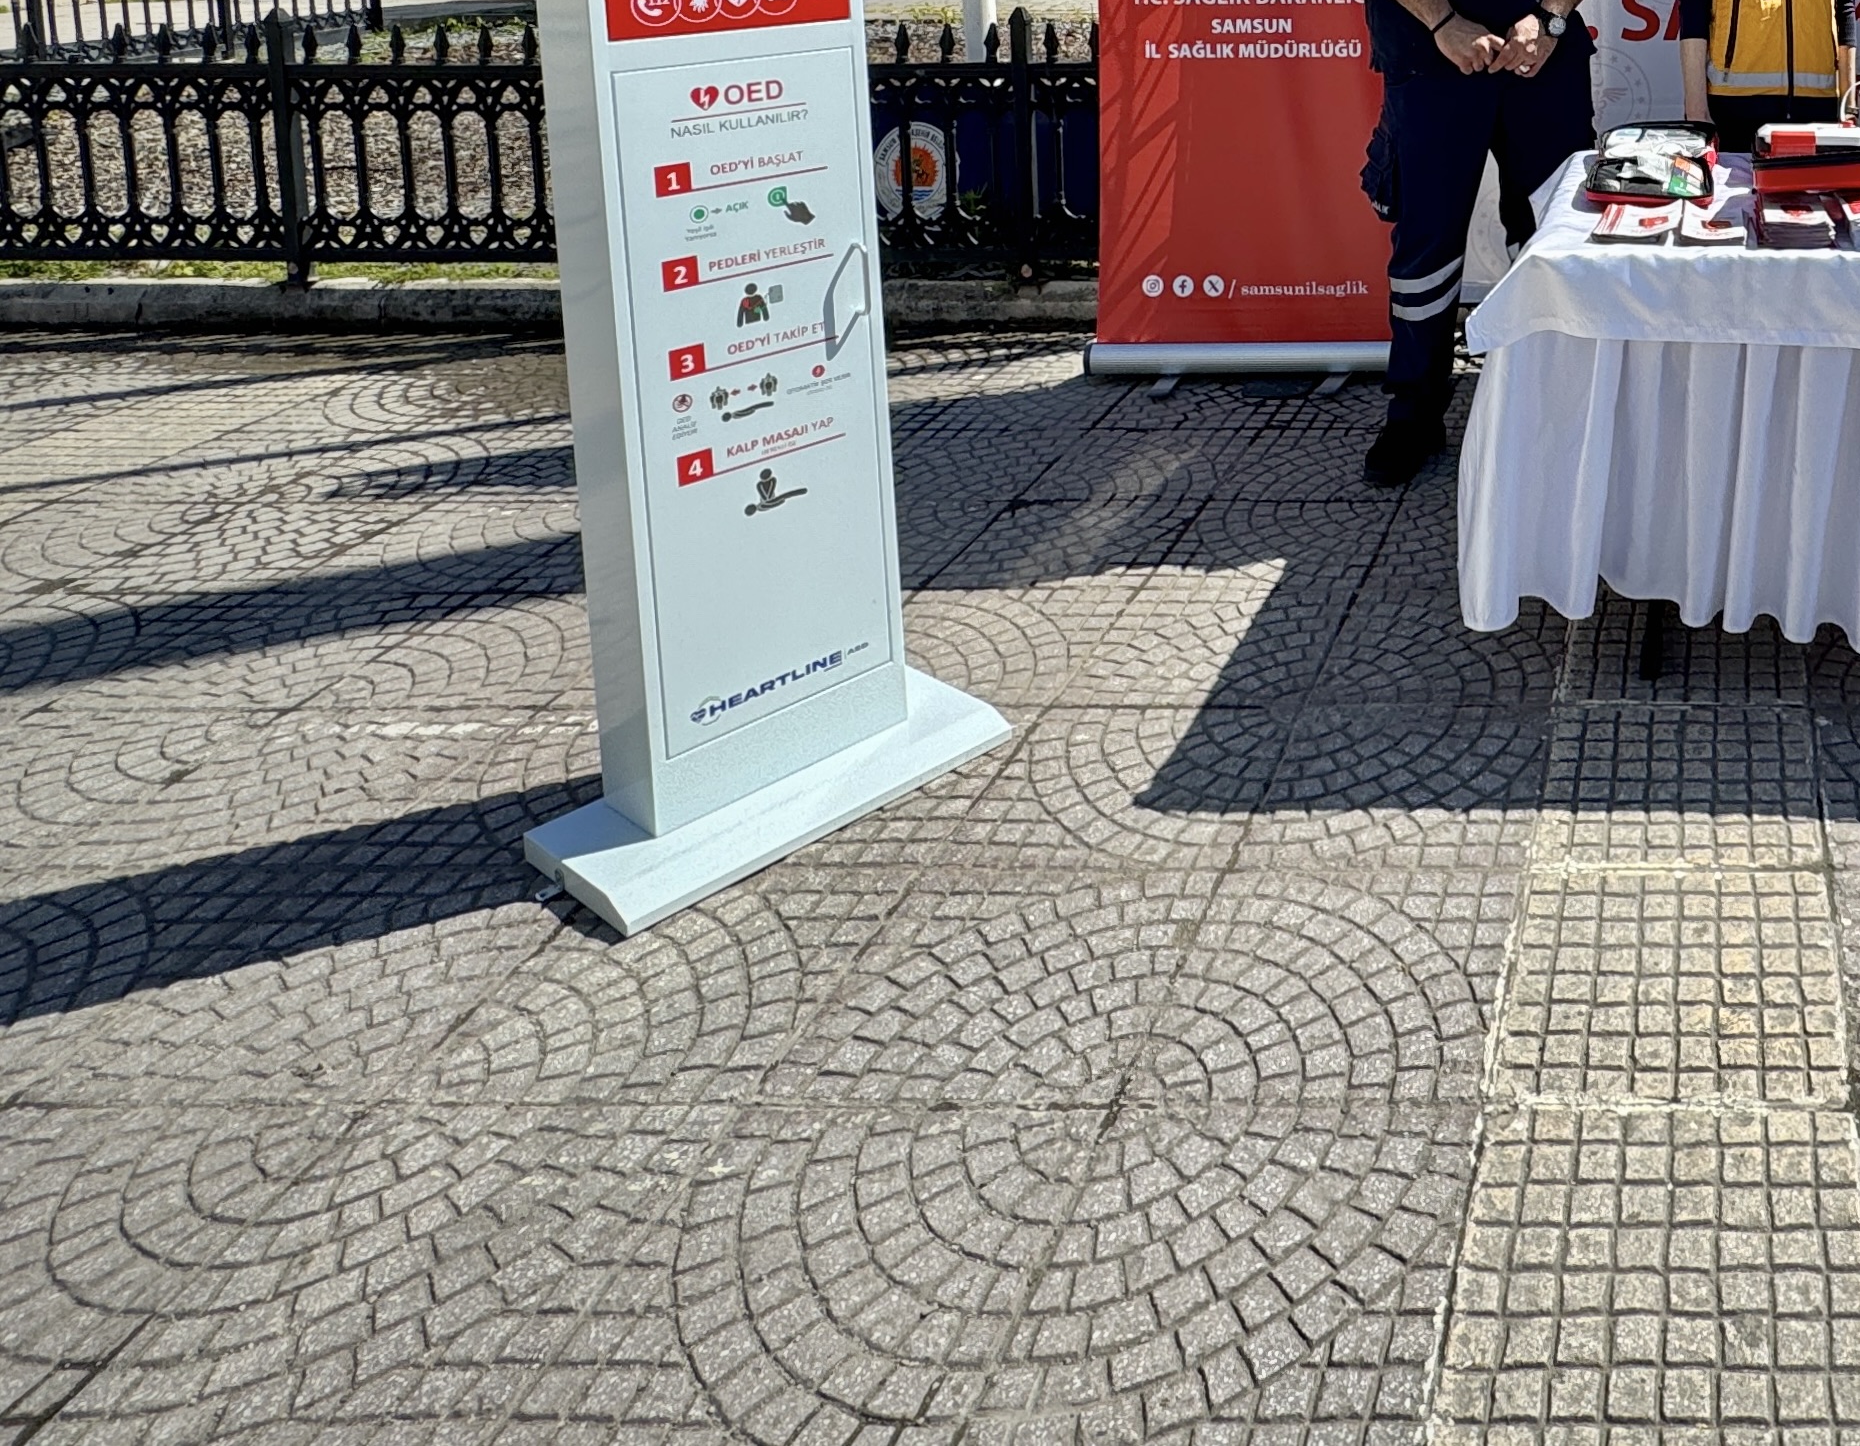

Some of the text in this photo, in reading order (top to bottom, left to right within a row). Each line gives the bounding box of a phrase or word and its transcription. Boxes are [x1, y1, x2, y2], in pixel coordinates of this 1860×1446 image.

[1211, 18, 1293, 34] SAMSUN
[1145, 39, 1362, 59] İL SAĞLIK MÜDÜRLÜĞÜ
[724, 80, 783, 105] OED
[671, 109, 809, 138] NASIL KULLANILIR?
[666, 151, 803, 191] 1 OED'Yİ BAŞLAT
[725, 201, 749, 213] AÇIK
[673, 238, 826, 285] 2 PEDLERİ YERLEŞTİR
[680, 354, 695, 374] 3
[774, 324, 809, 345] TAKİP
[688, 417, 834, 477] 4 KALP MASAJI YAP
[709, 650, 842, 718] HEARTLINE
